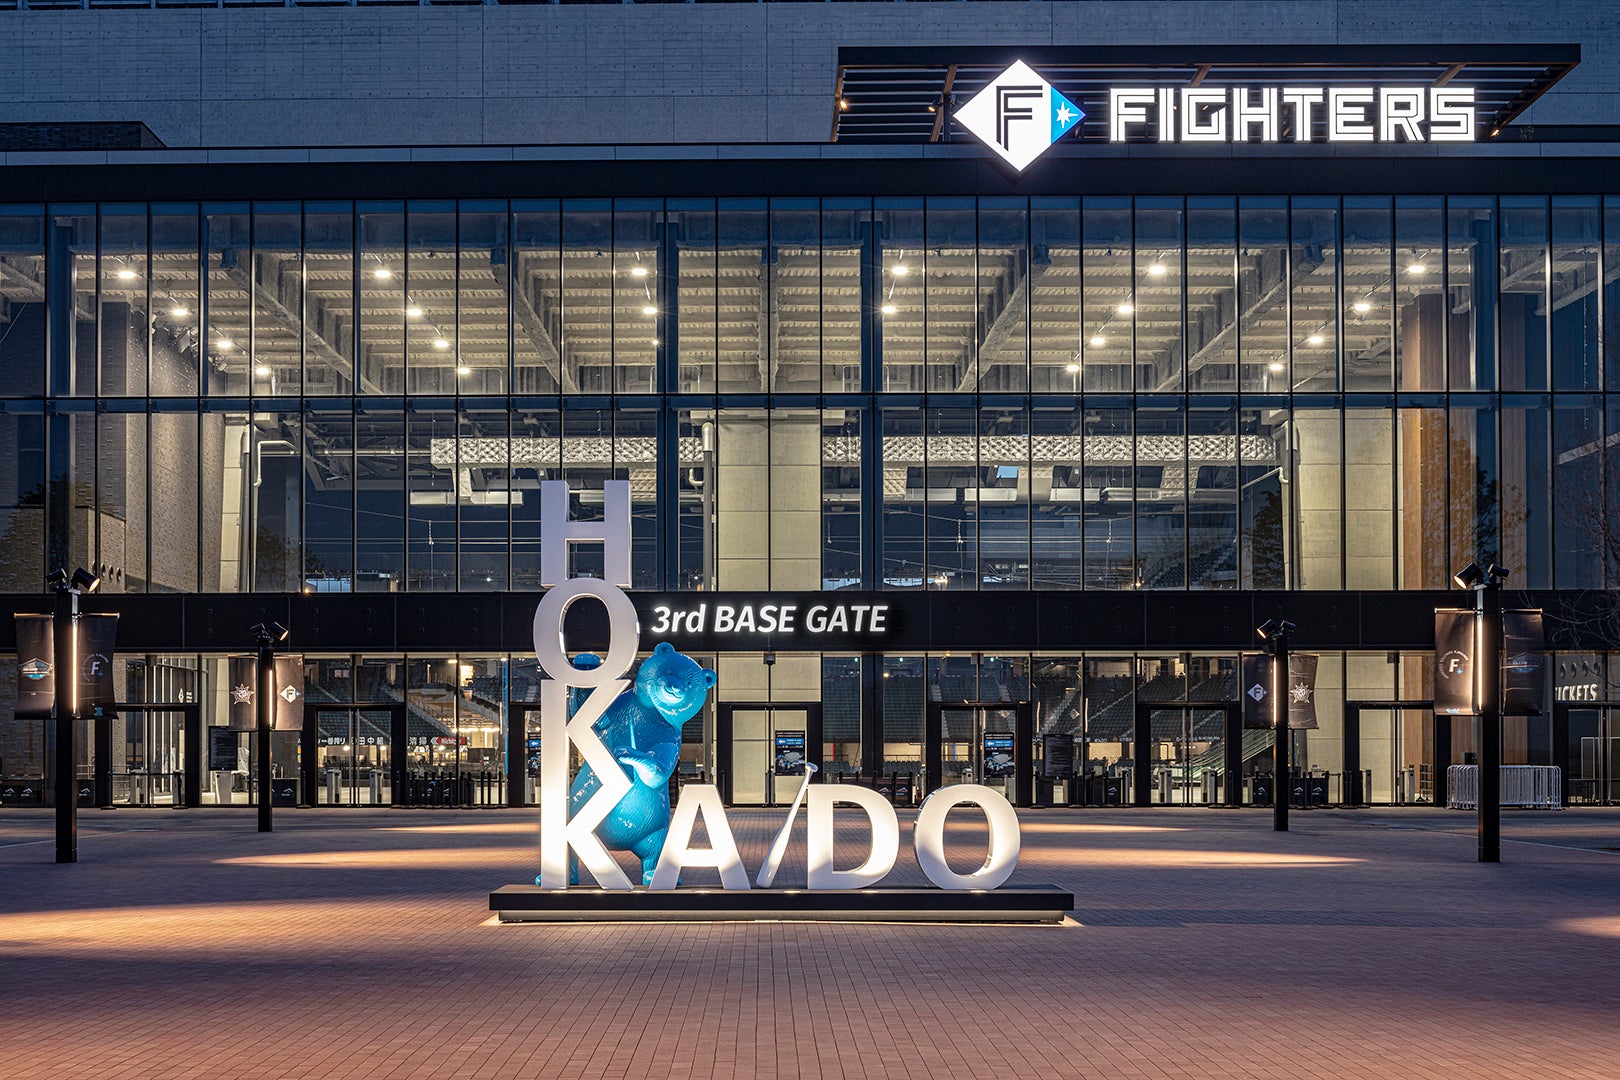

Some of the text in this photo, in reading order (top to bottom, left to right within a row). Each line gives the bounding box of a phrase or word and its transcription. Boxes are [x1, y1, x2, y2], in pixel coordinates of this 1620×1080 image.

[1109, 87, 1476, 142] FIGHTERS
[651, 603, 889, 633] 3rd BASE GATE
